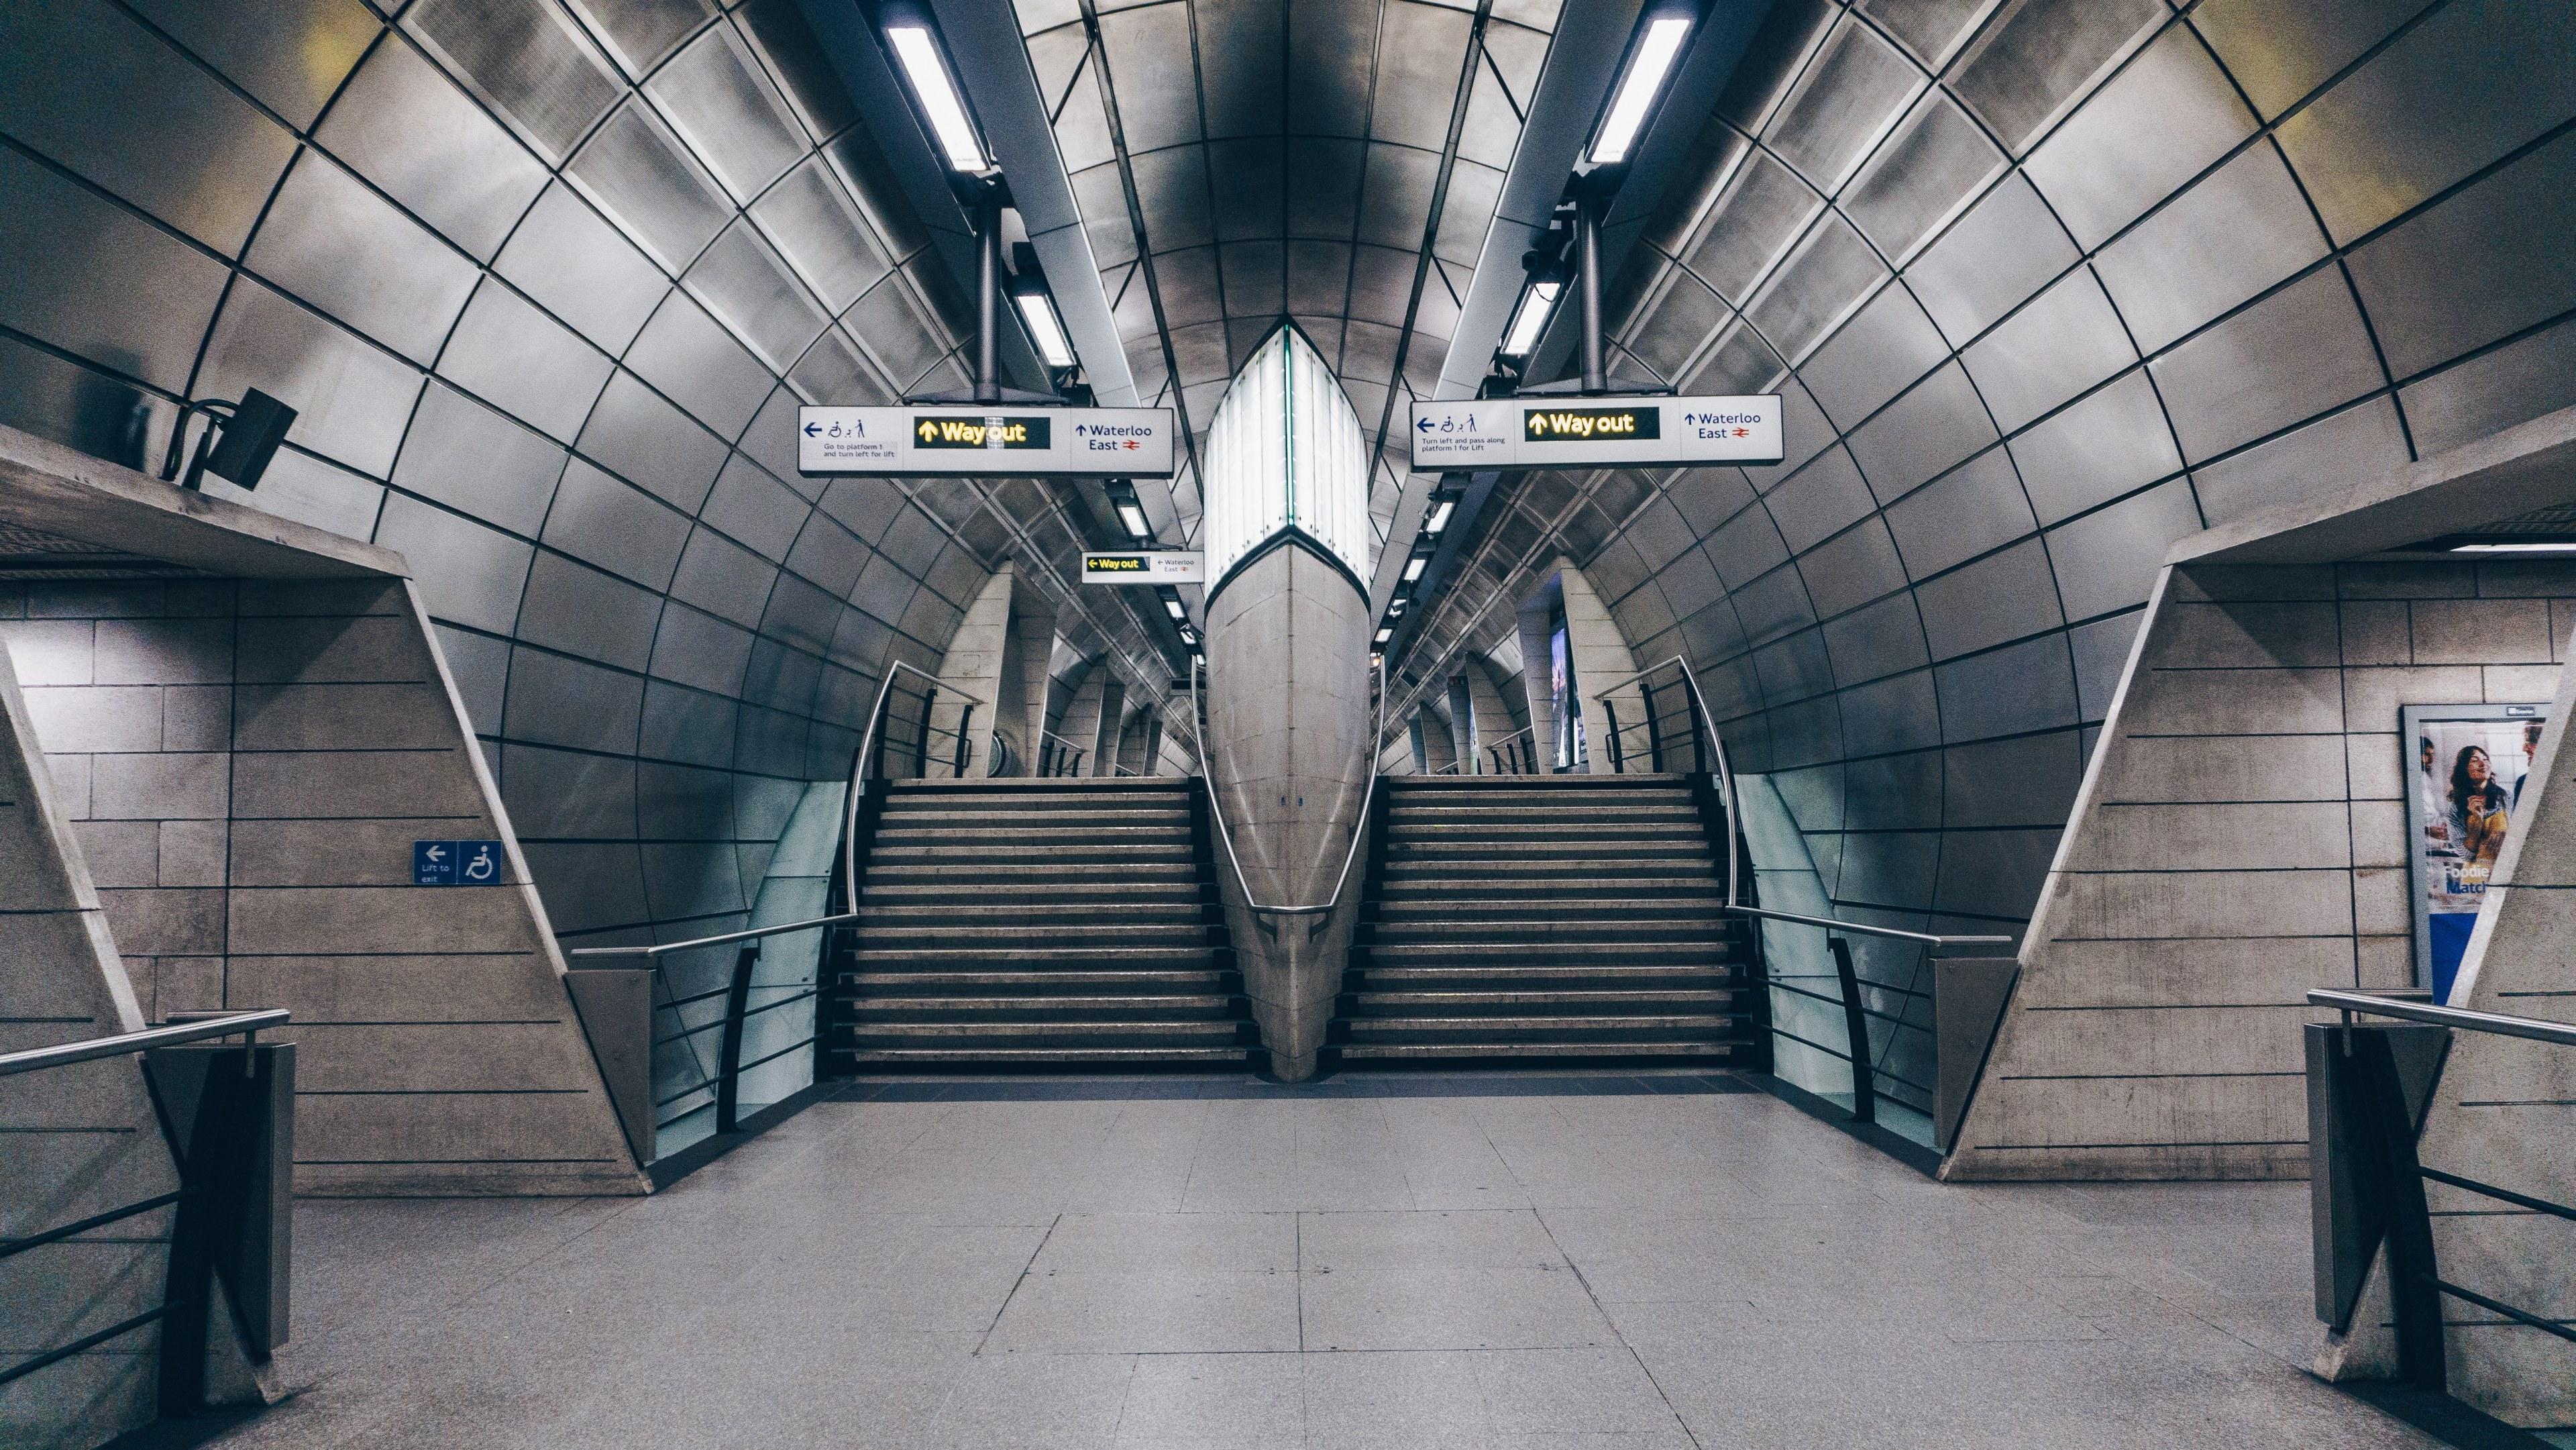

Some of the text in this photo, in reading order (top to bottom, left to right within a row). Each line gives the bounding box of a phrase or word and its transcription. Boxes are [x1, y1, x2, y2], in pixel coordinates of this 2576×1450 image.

[1699, 413, 1761, 424] Waterloo
[1550, 413, 1634, 436] Way out
[941, 422, 1026, 444] Way out
[1089, 425, 1152, 436] Waterloo
[1699, 428, 1727, 439] East
[1089, 440, 1118, 450] East
[1099, 559, 1138, 569] Way out
[2444, 866, 2490, 878] Foodie
